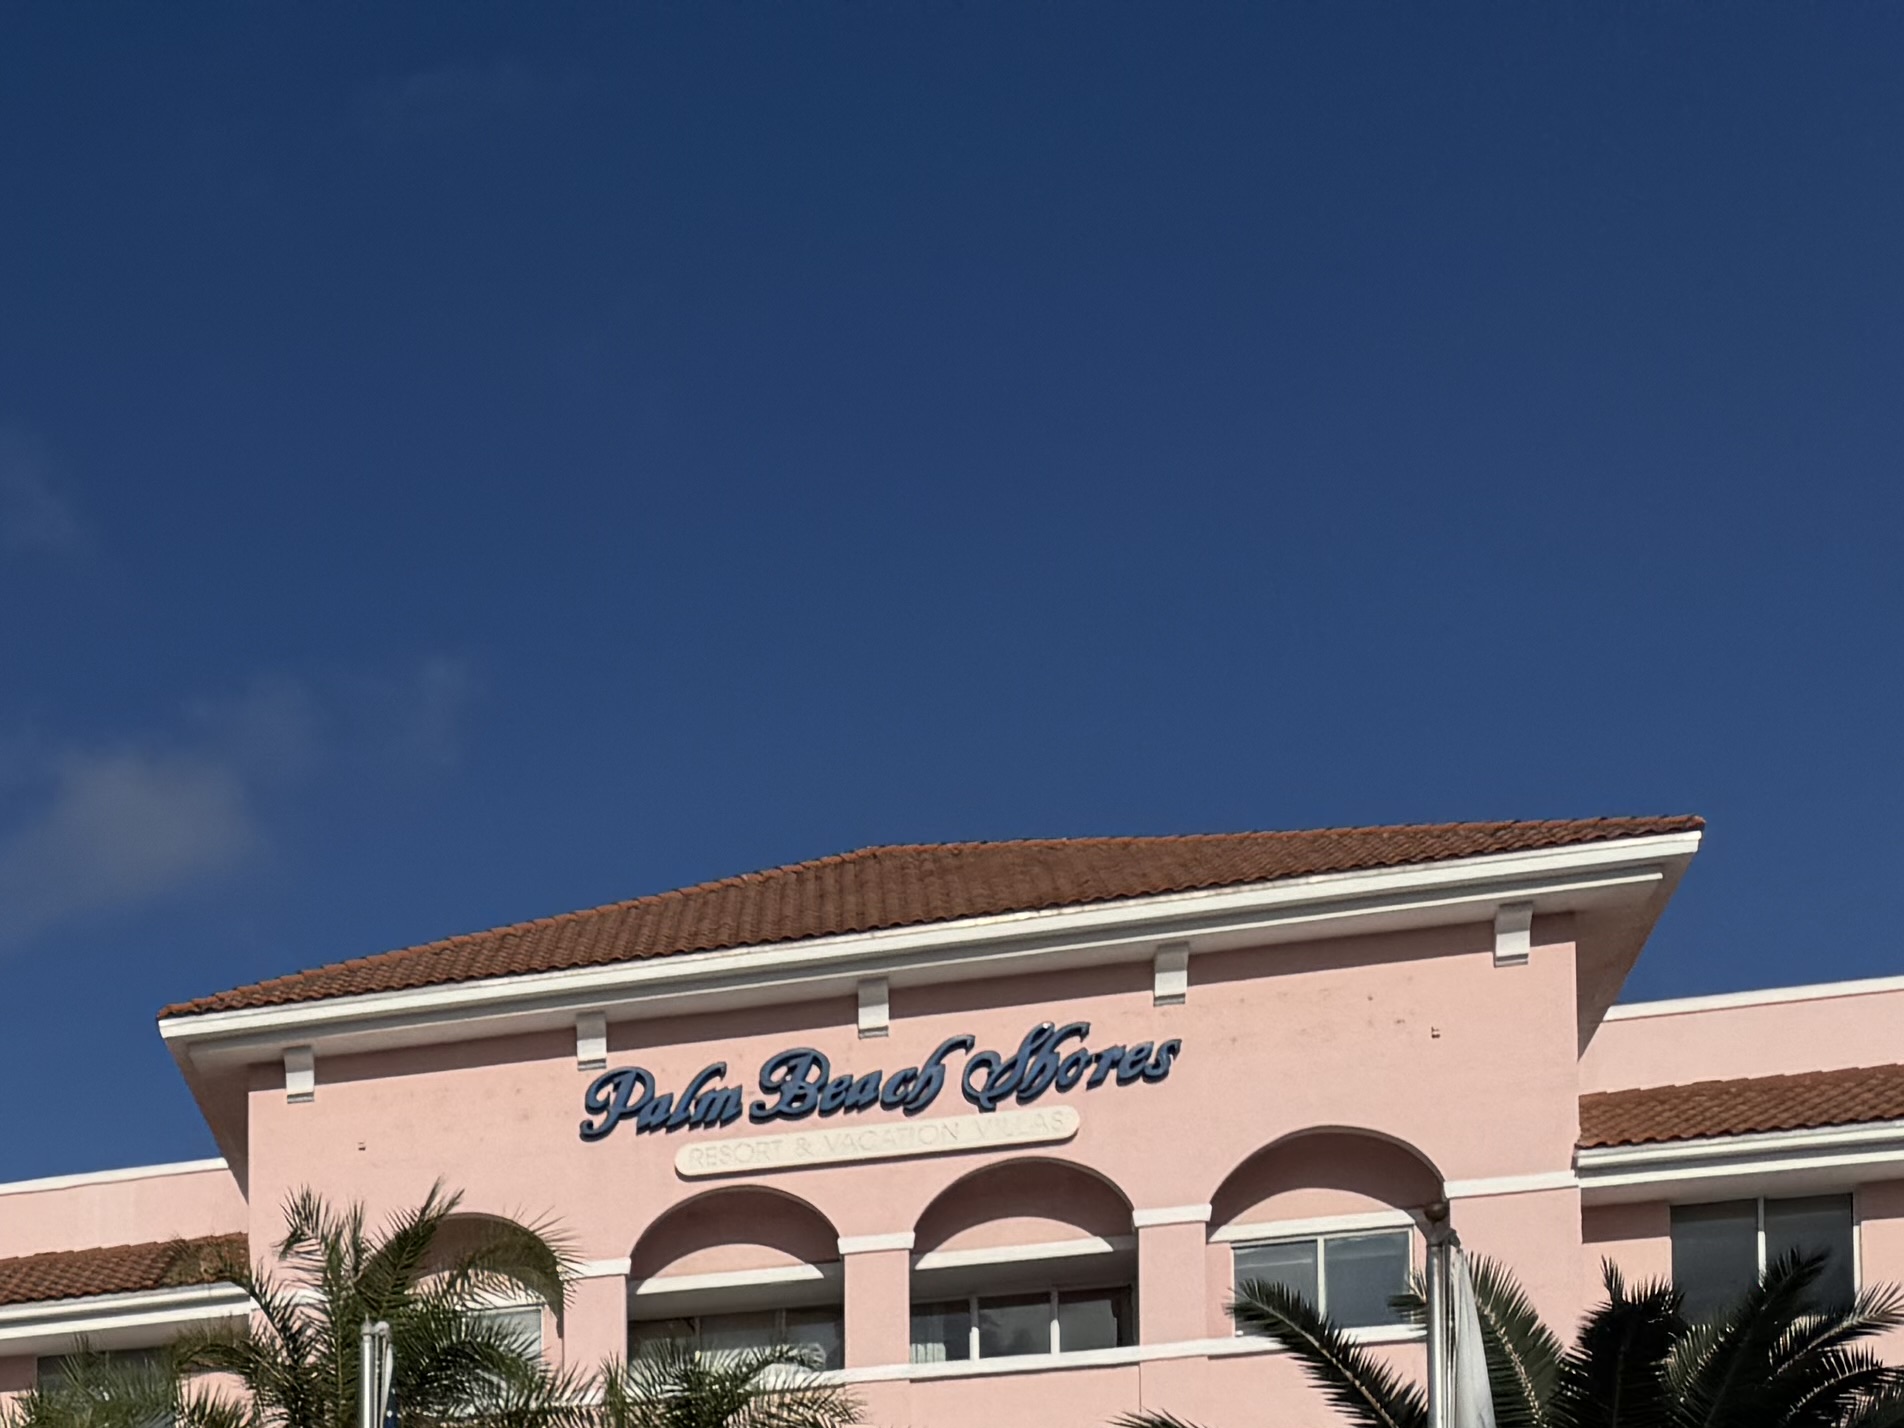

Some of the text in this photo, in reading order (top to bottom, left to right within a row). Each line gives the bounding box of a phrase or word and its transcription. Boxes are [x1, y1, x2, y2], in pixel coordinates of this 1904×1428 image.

[580, 1021, 1183, 1142] Palm Beach Shores
[691, 1111, 1065, 1169] RESORT & VACATION VILLAS
